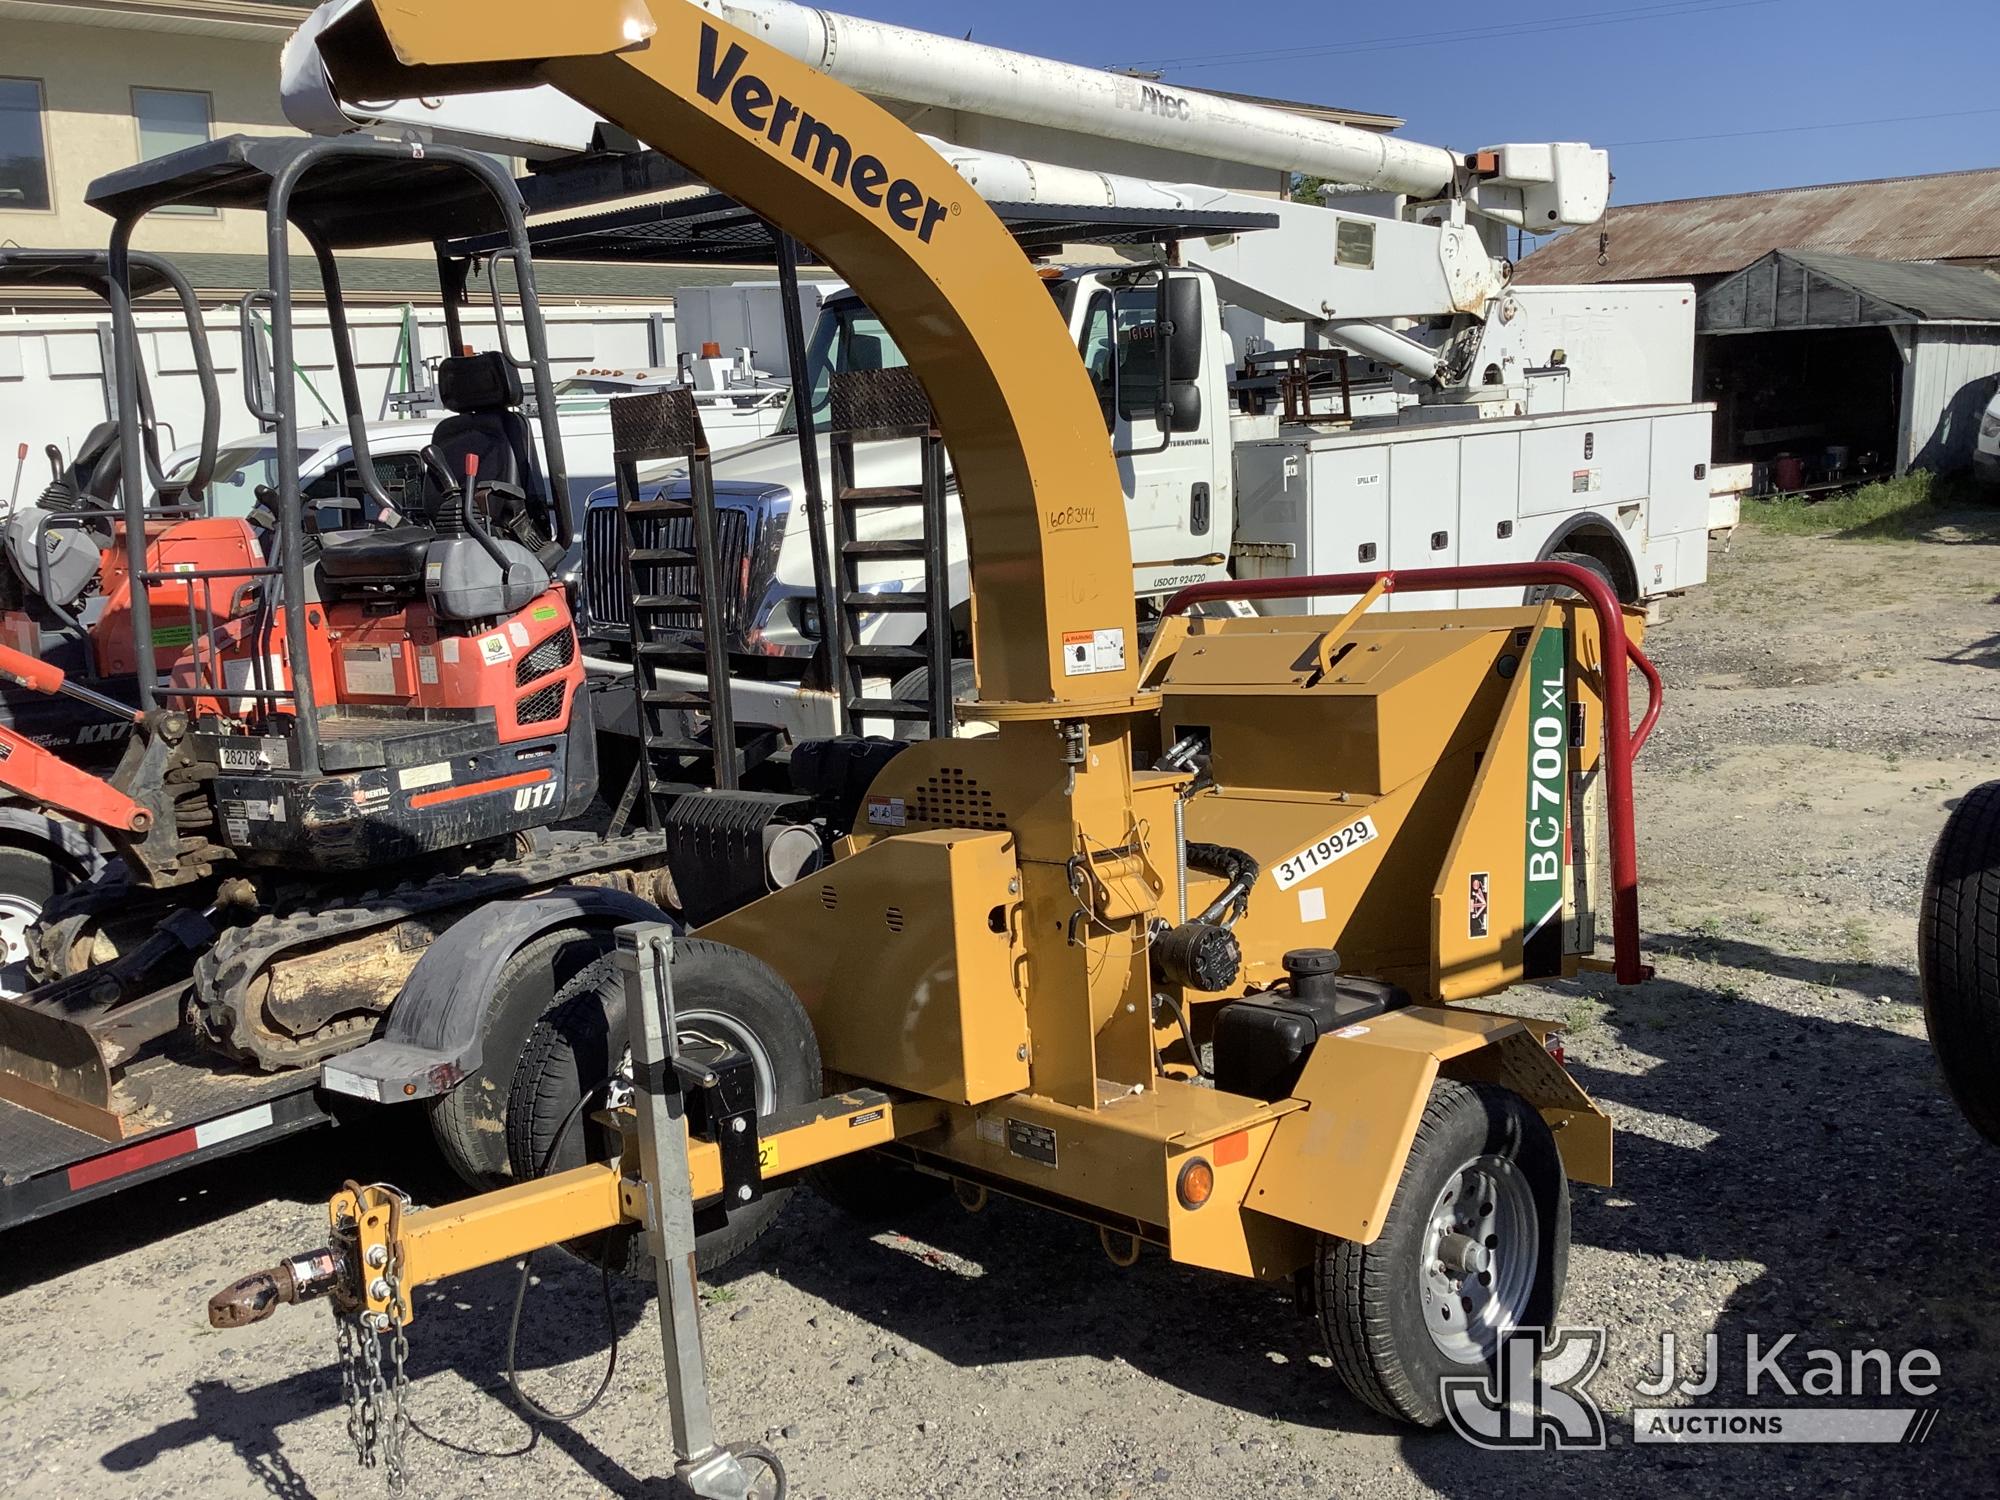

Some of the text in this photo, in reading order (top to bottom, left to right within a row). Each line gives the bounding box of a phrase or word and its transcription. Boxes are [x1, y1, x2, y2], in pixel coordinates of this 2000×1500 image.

[1140, 85, 1191, 121] Altec
[696, 21, 948, 244] Vermeer
[1169, 438, 1210, 447] TERNATIONAL
[1045, 507, 1096, 528] 1608344
[1153, 573, 1206, 587] USDOT 924720
[1542, 668, 1564, 711] XL
[76, 721, 133, 744] KX7
[365, 787, 390, 799] RENTAL
[514, 781, 558, 812] U17
[1280, 821, 1368, 881] 3119929
